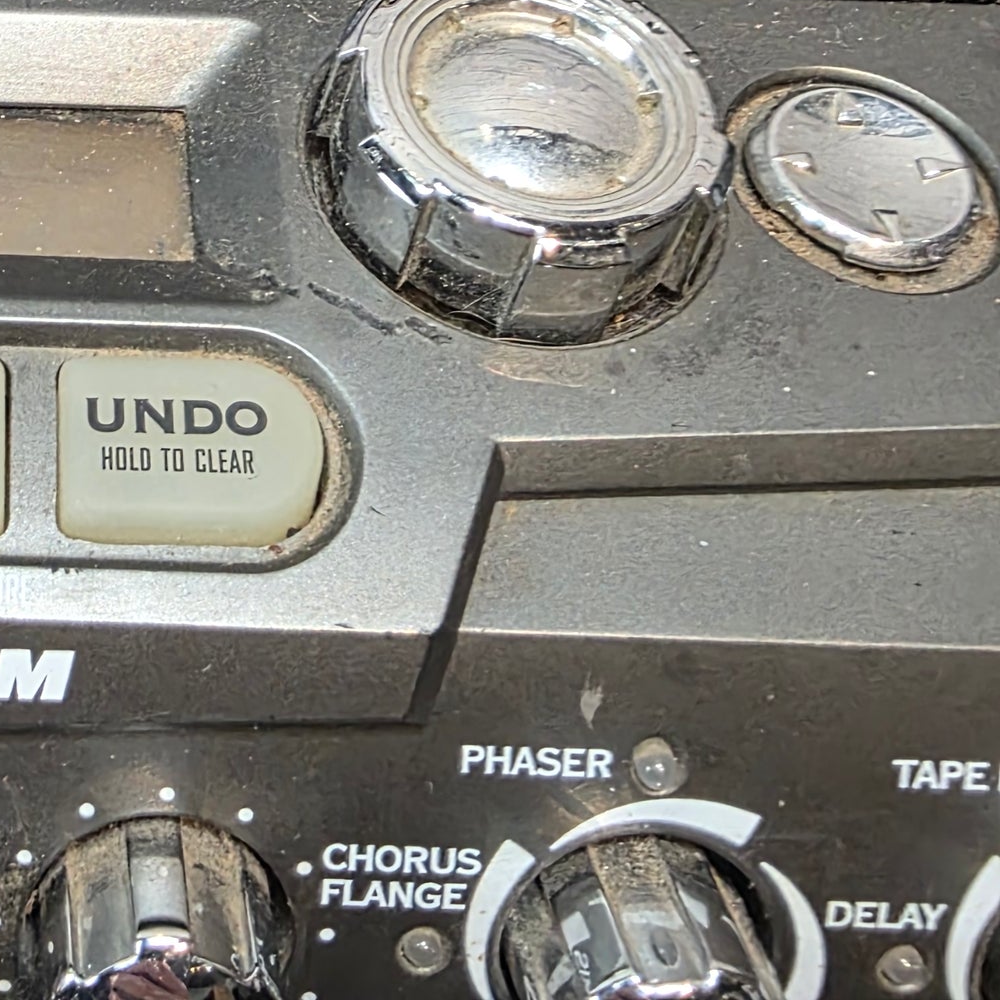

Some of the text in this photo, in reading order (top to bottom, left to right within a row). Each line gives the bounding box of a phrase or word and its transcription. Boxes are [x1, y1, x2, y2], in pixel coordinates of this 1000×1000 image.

[85, 397, 268, 437] UNDO
[101, 446, 255, 475] HOLD TO CLEAR
[460, 744, 614, 779] PHASER
[891, 759, 991, 792] TAPE
[321, 842, 483, 876] CHORUS
[319, 877, 468, 911] FLANGE
[824, 900, 949, 931] DELAY
